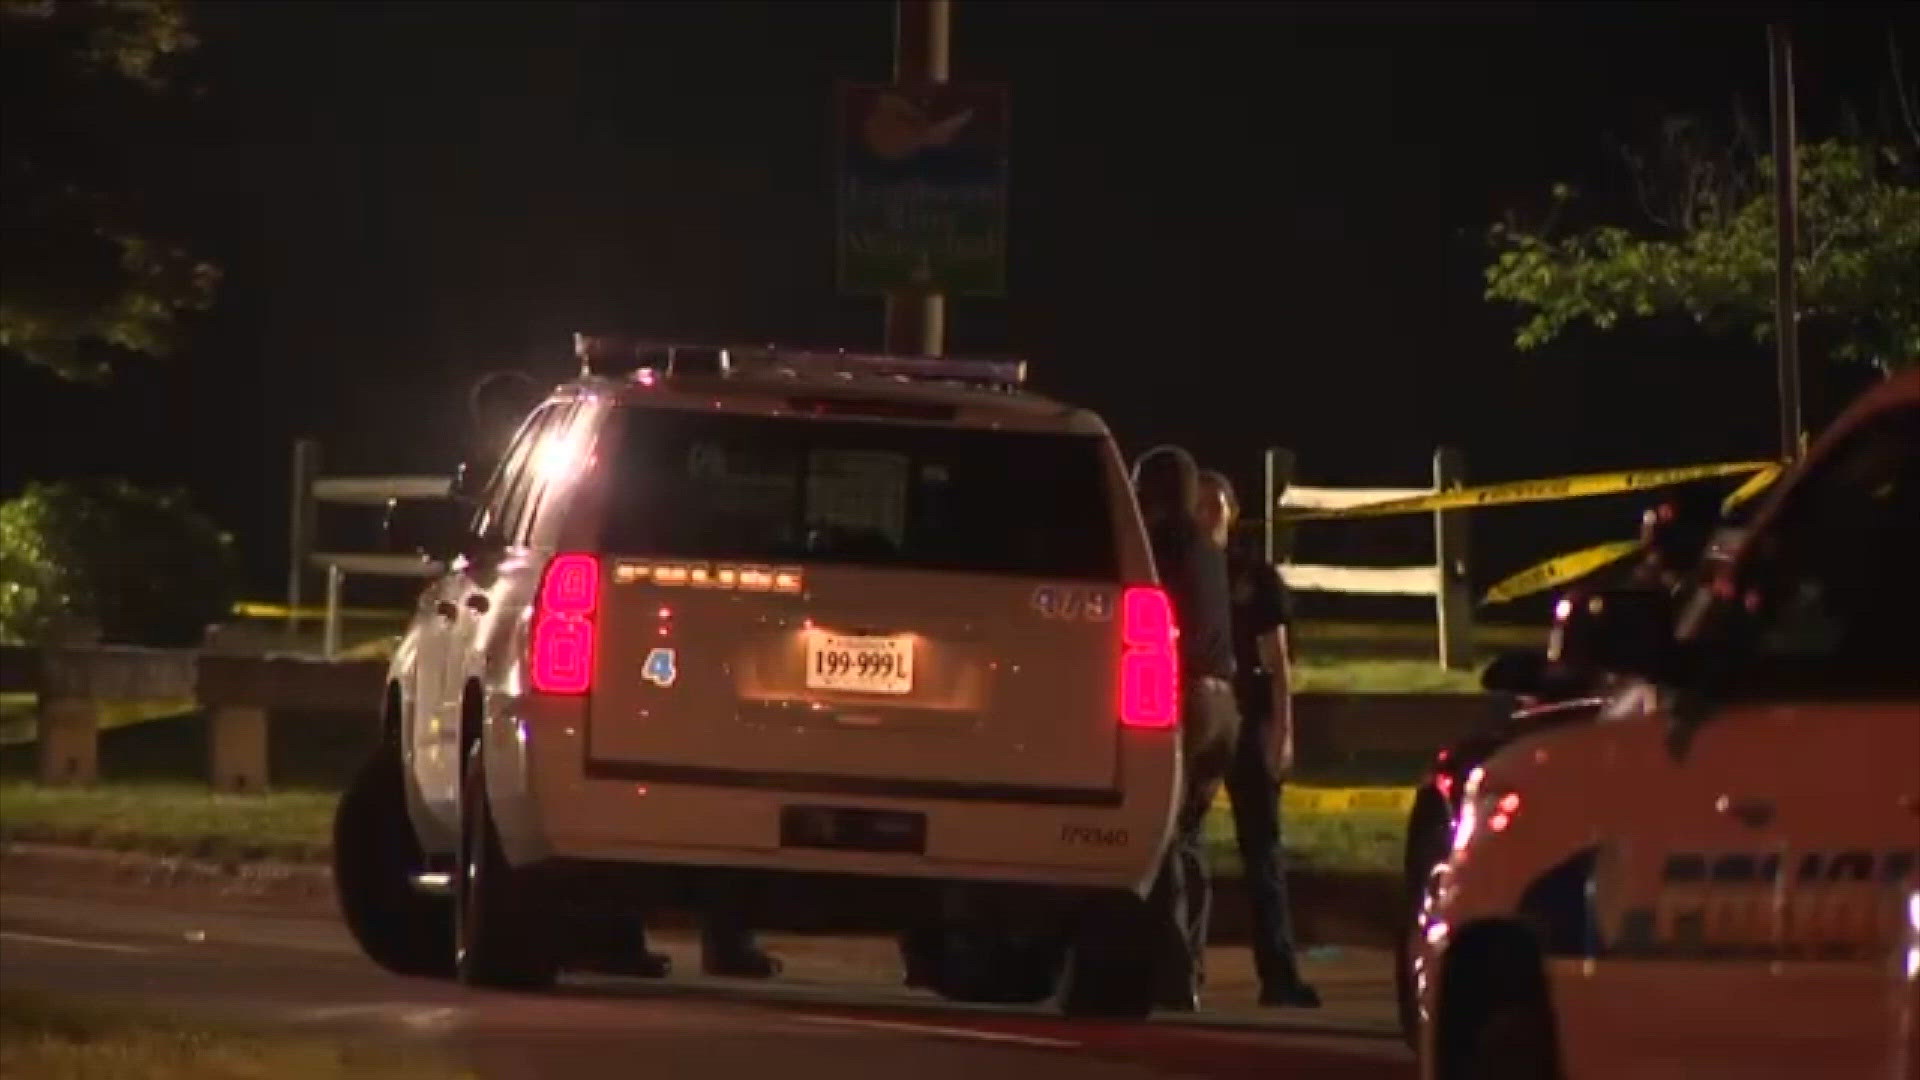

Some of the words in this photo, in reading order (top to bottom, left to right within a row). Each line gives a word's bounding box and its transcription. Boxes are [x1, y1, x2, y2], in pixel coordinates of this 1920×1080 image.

[613, 559, 803, 593] POLICE
[641, 647, 676, 688] 4
[816, 651, 906, 679] 199-999L
